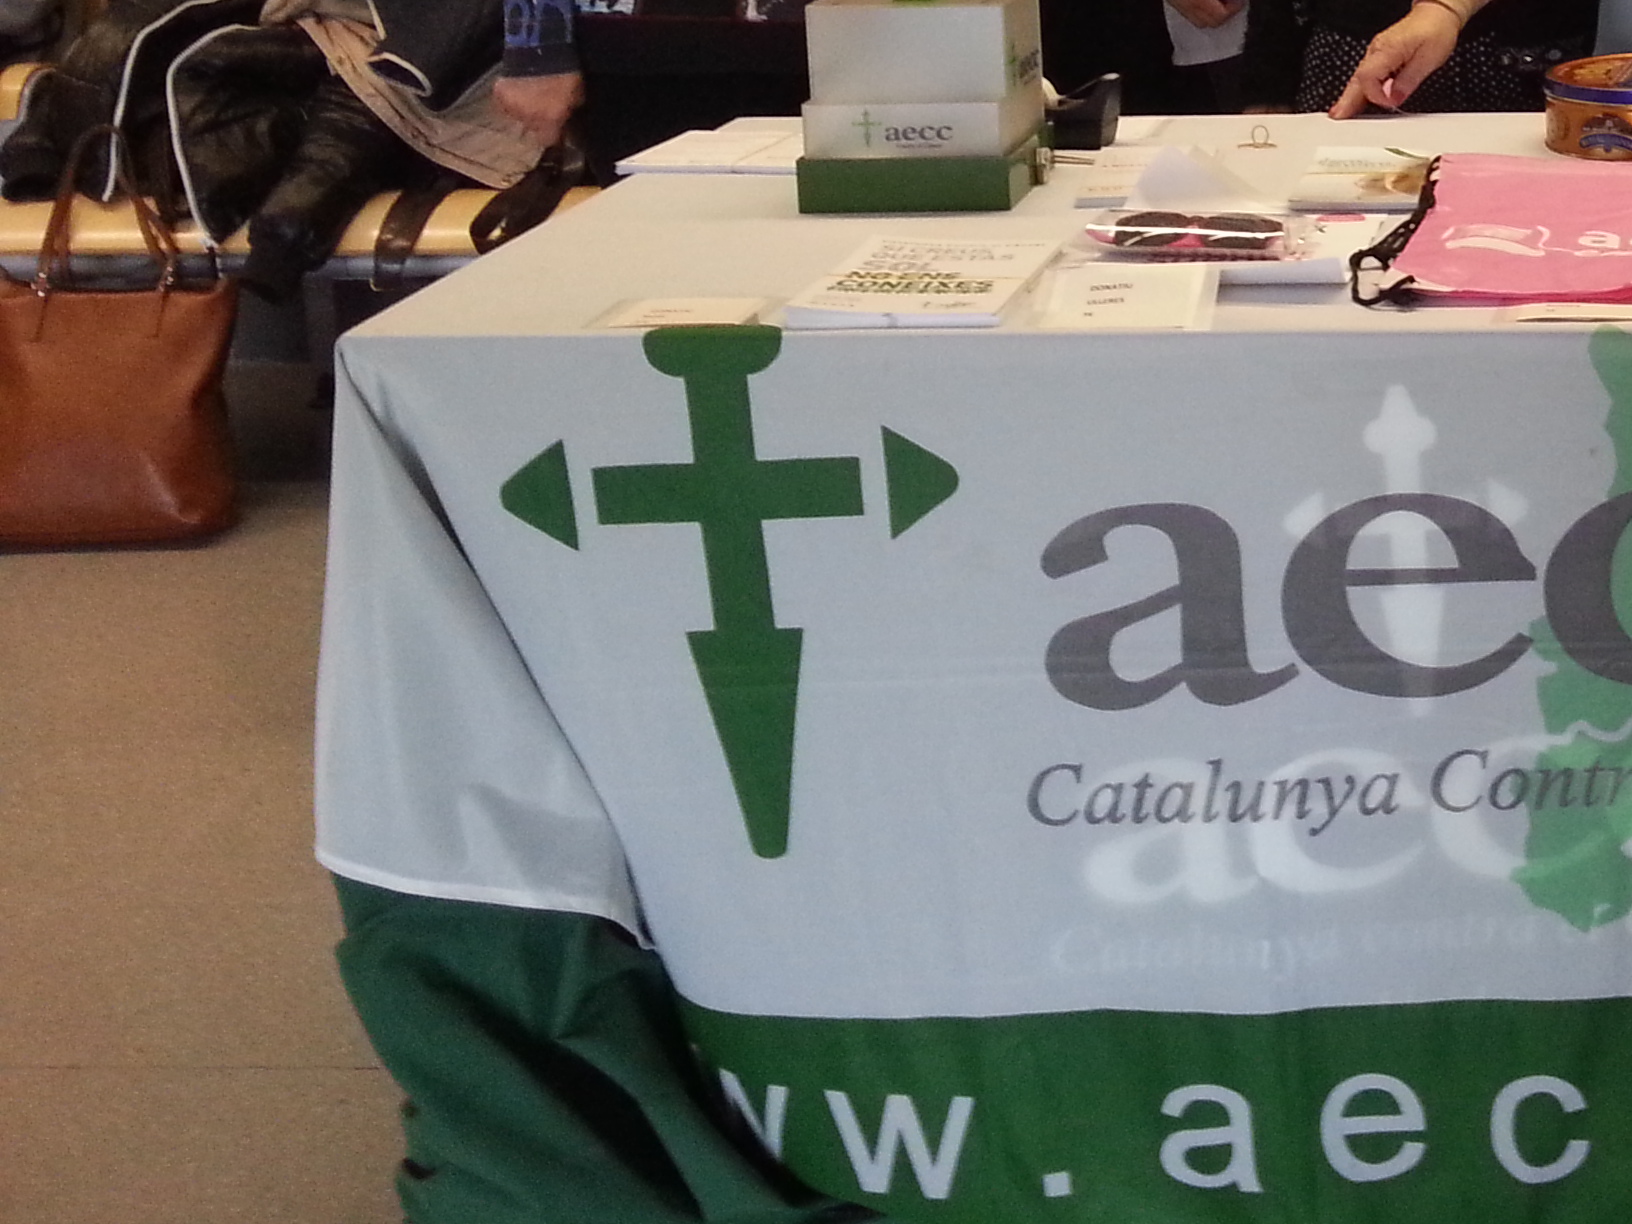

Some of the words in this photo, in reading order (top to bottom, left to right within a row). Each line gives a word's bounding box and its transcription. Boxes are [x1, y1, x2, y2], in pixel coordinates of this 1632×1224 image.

[884, 125, 954, 142] aecc
[845, 270, 893, 280] NO
[1026, 759, 1402, 837] Catalunya
